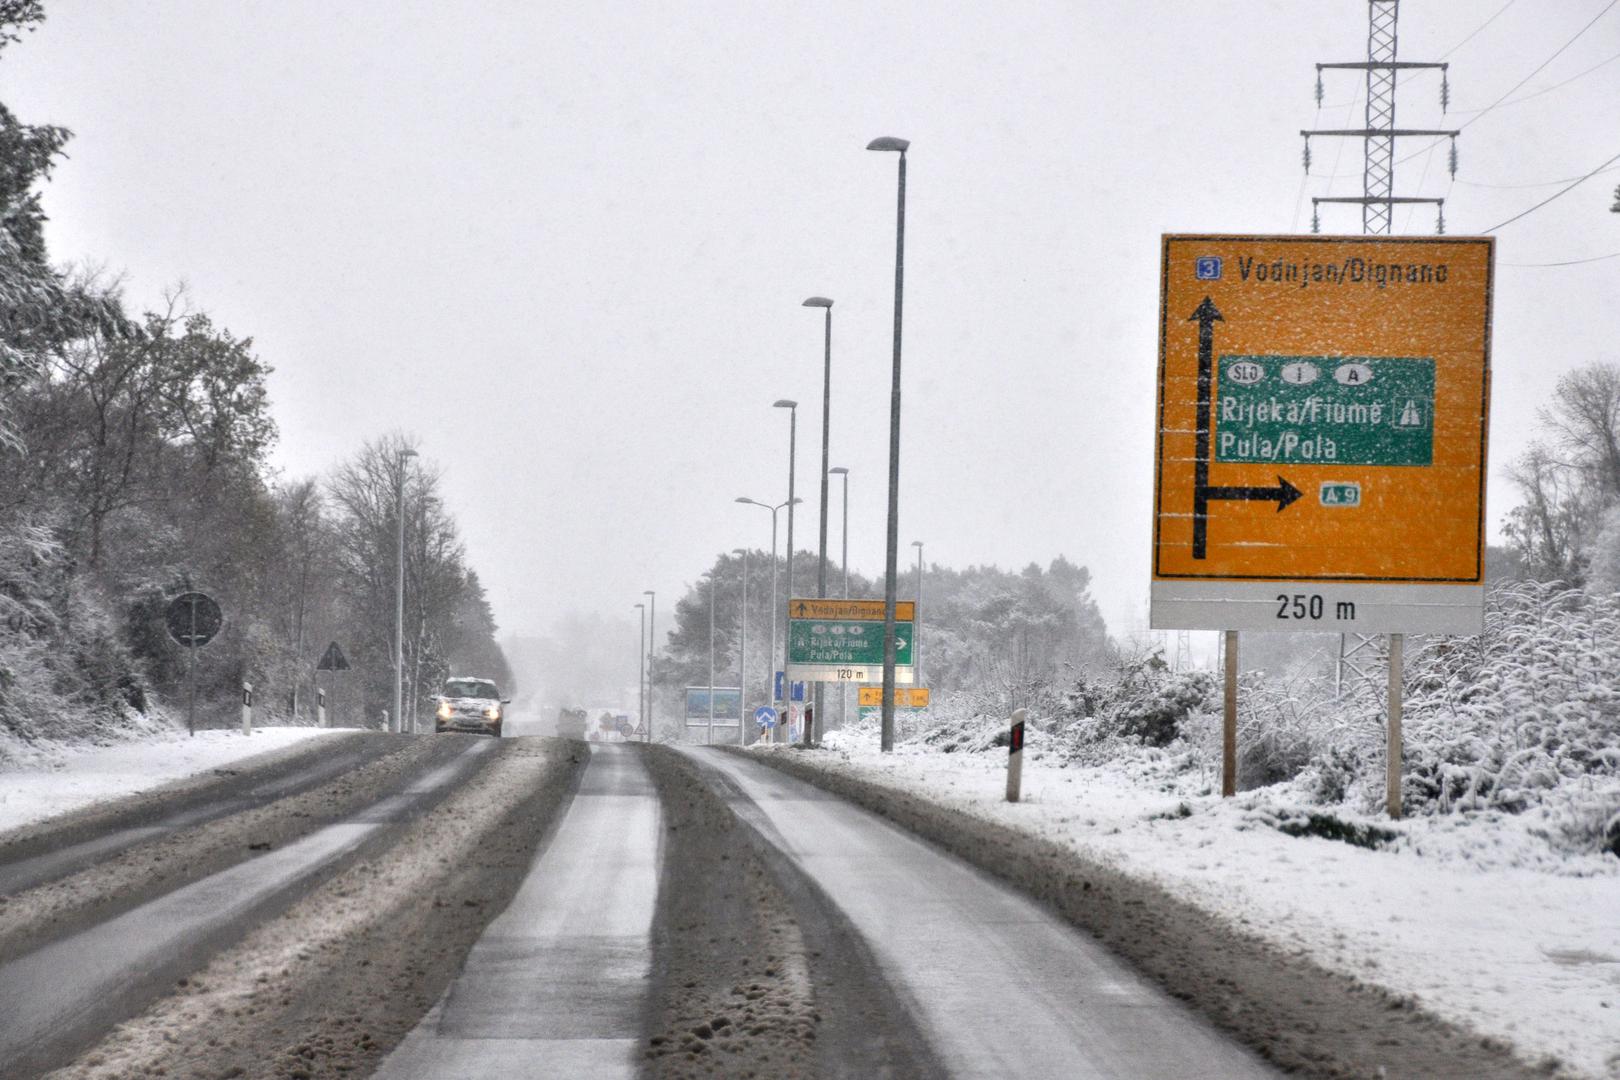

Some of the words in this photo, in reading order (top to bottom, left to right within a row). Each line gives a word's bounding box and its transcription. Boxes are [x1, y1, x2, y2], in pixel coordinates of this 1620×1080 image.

[1203, 262, 1215, 277] 3
[1239, 256, 1448, 289] Vodnjan/Dignano
[1233, 366, 1258, 381] SLO
[1347, 368, 1359, 382] A
[1221, 396, 1383, 427] Rijeka/Fiume
[1220, 430, 1337, 460] Pula/Pola
[1276, 594, 1323, 620] 250
[1336, 600, 1356, 620] m
[810, 650, 853, 660] Pula/Pola
[837, 669, 852, 679] 120
[856, 670, 864, 679] m
